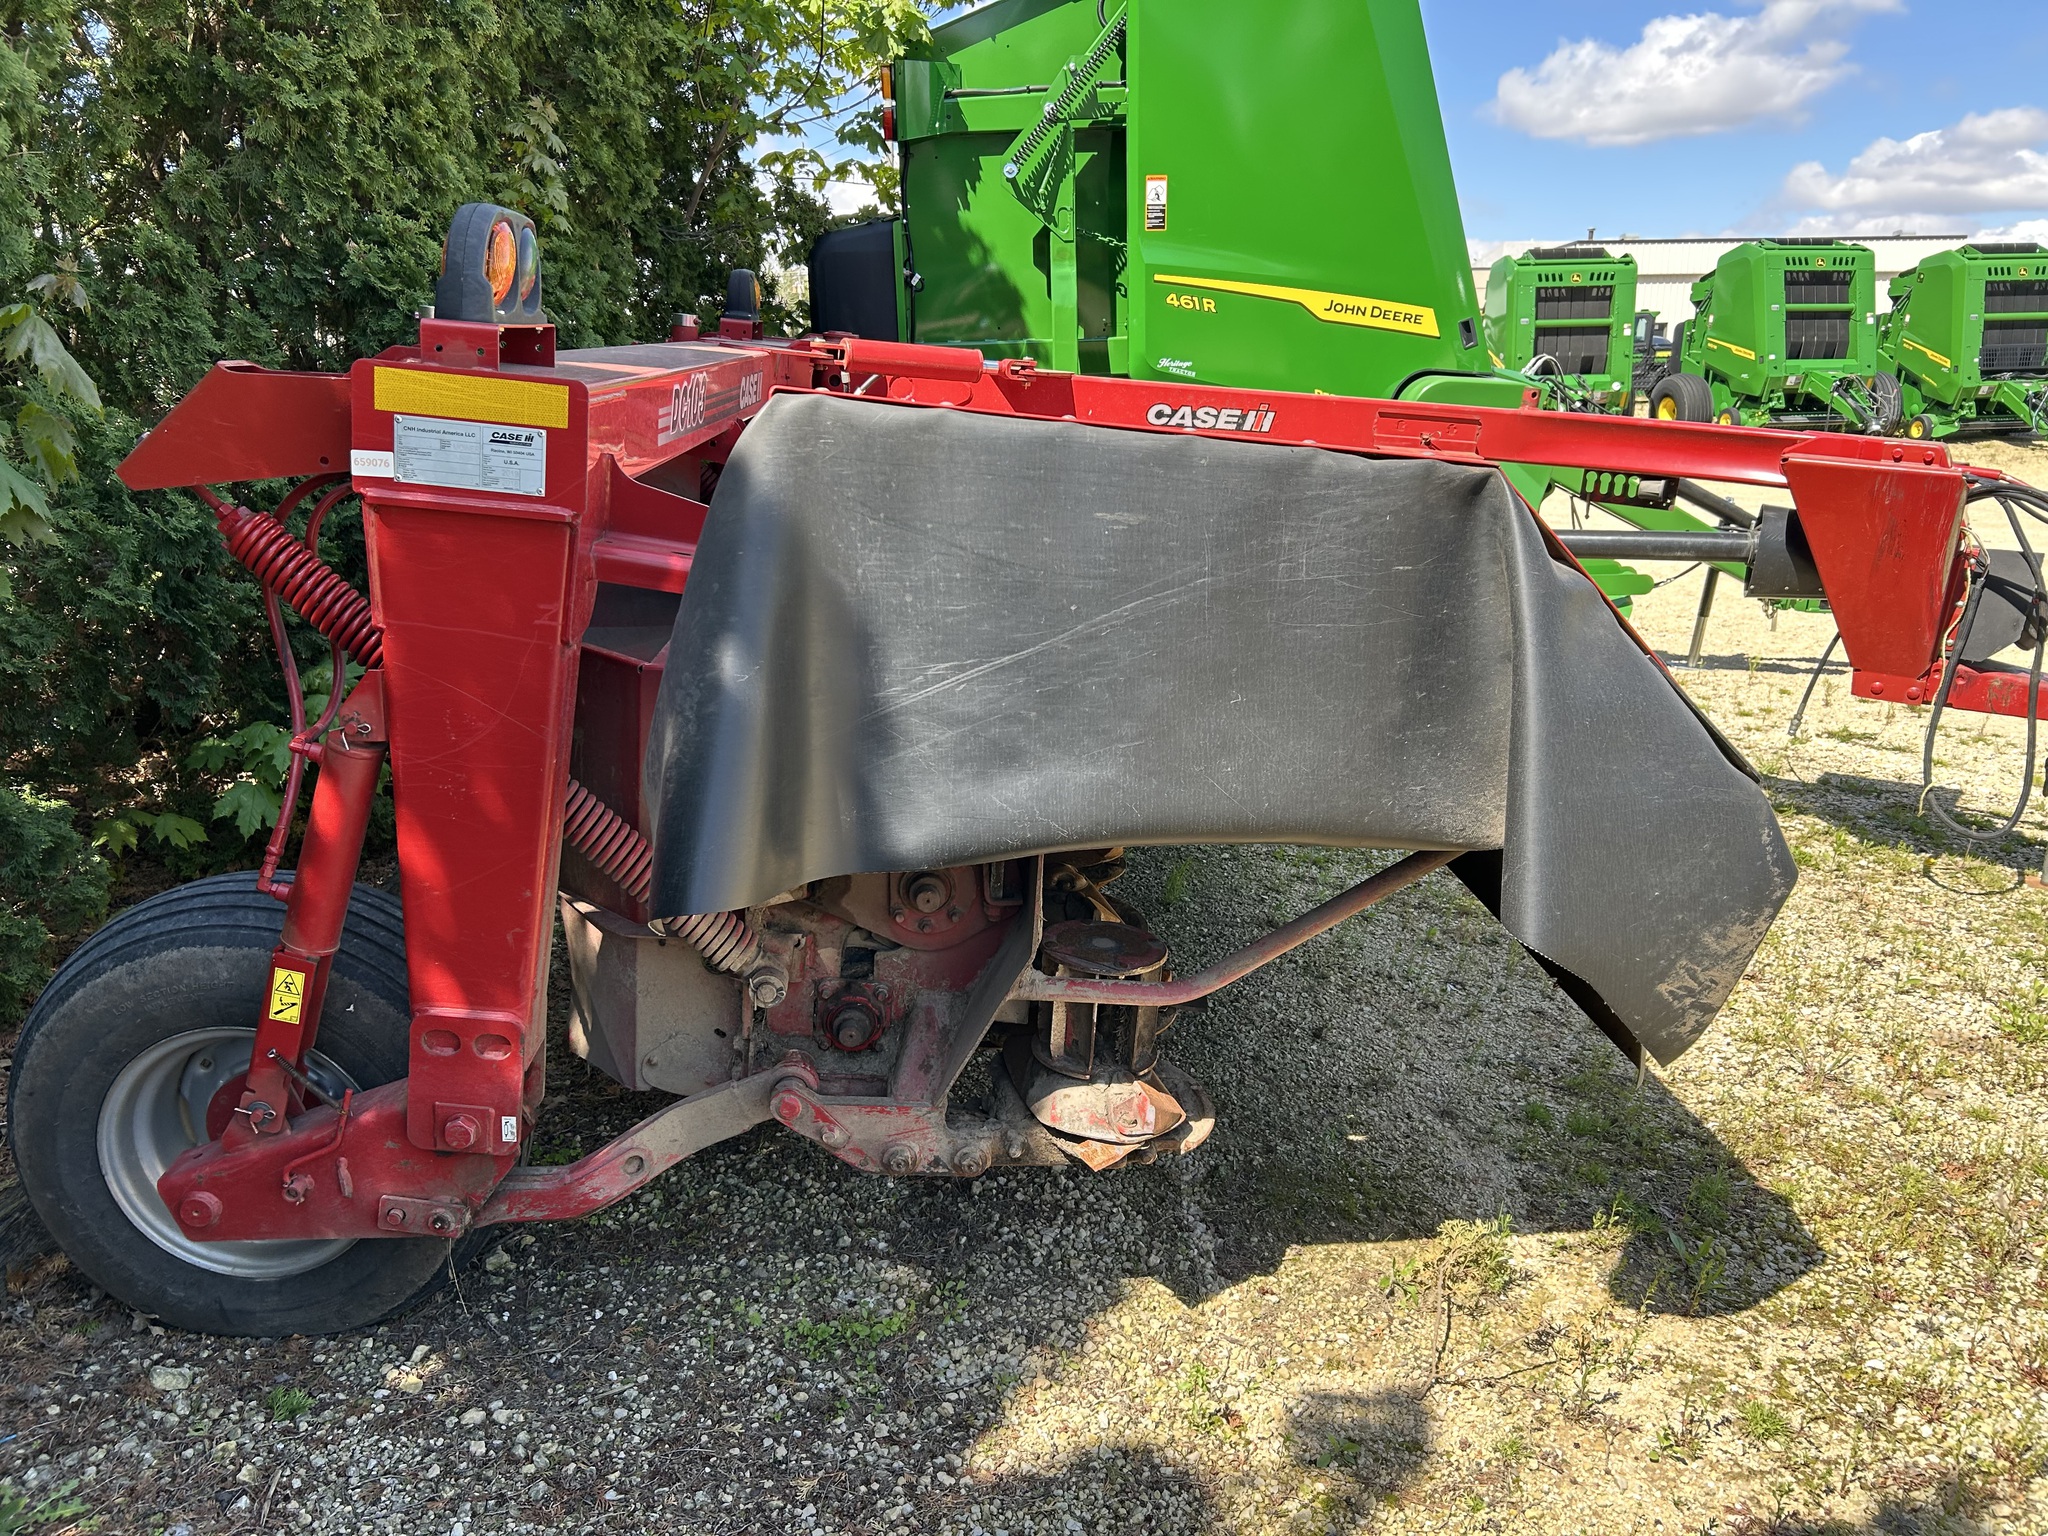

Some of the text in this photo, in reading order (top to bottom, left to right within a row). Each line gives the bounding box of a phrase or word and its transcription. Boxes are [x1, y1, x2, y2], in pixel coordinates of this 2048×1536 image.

[1323, 299, 1424, 325] JOHN DEERE
[1156, 357, 1193, 369] Heritage
[740, 373, 758, 410] CASE
[1146, 402, 1243, 431] CASE
[442, 429, 464, 437] America
[491, 431, 524, 441] CASE
[353, 457, 390, 468] 659076
[112, 979, 235, 1016] LOW SECTION HEIGHT
